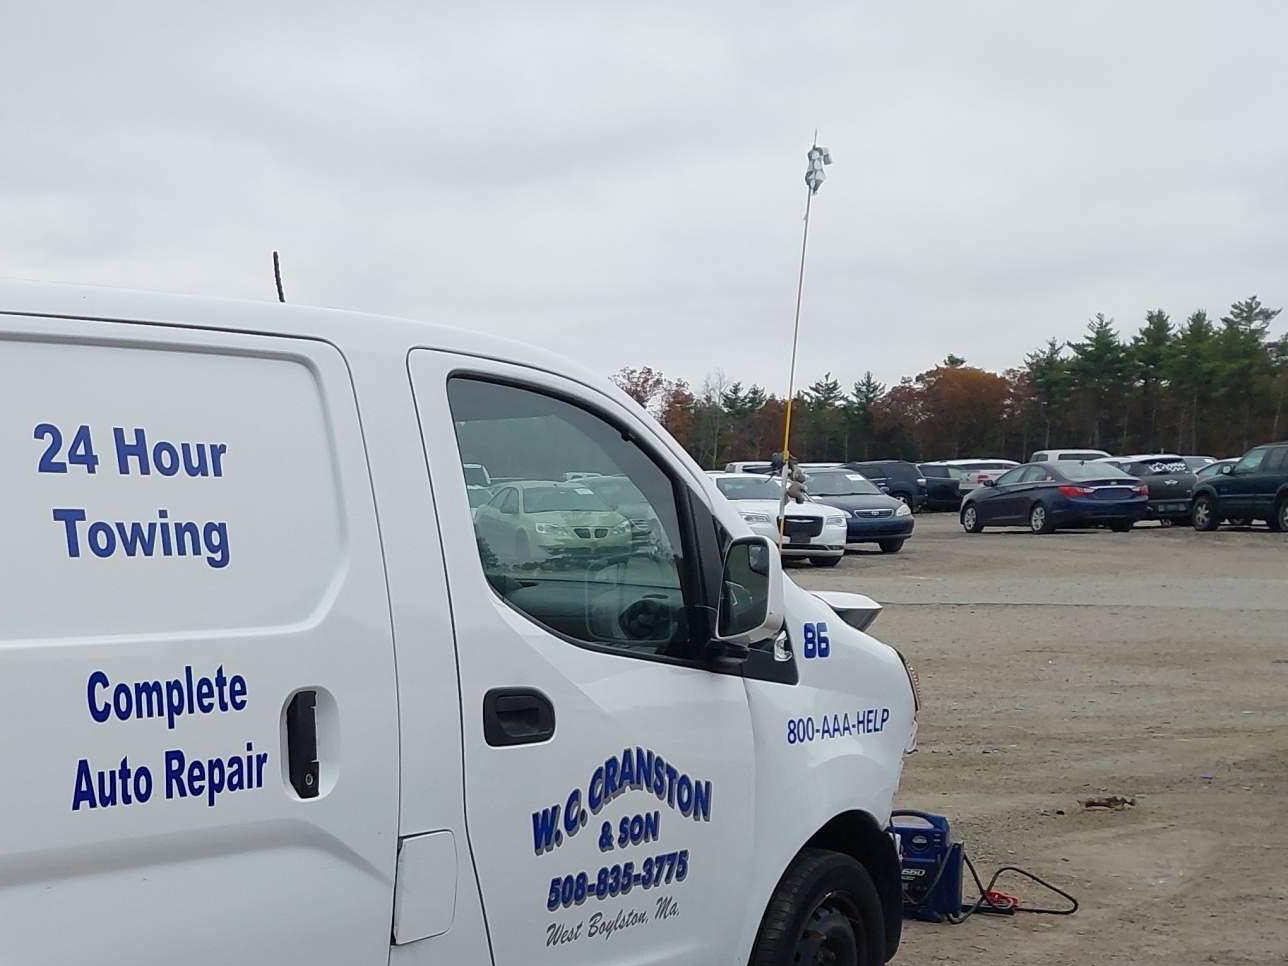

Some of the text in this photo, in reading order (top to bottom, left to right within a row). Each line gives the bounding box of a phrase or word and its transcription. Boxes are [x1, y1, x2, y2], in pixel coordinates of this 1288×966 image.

[33, 423, 228, 477] 24 Hour
[53, 508, 230, 568] Towing
[804, 622, 830, 659] 86
[87, 665, 248, 729] Complete
[787, 708, 890, 745] 800-AAA-HELP
[72, 742, 268, 811] Auto Repair
[587, 747, 712, 822] CRANSTON
[598, 810, 660, 852] & SON
[547, 849, 690, 912] 508-835-3775
[546, 896, 680, 947] West Boylston, Ma.
